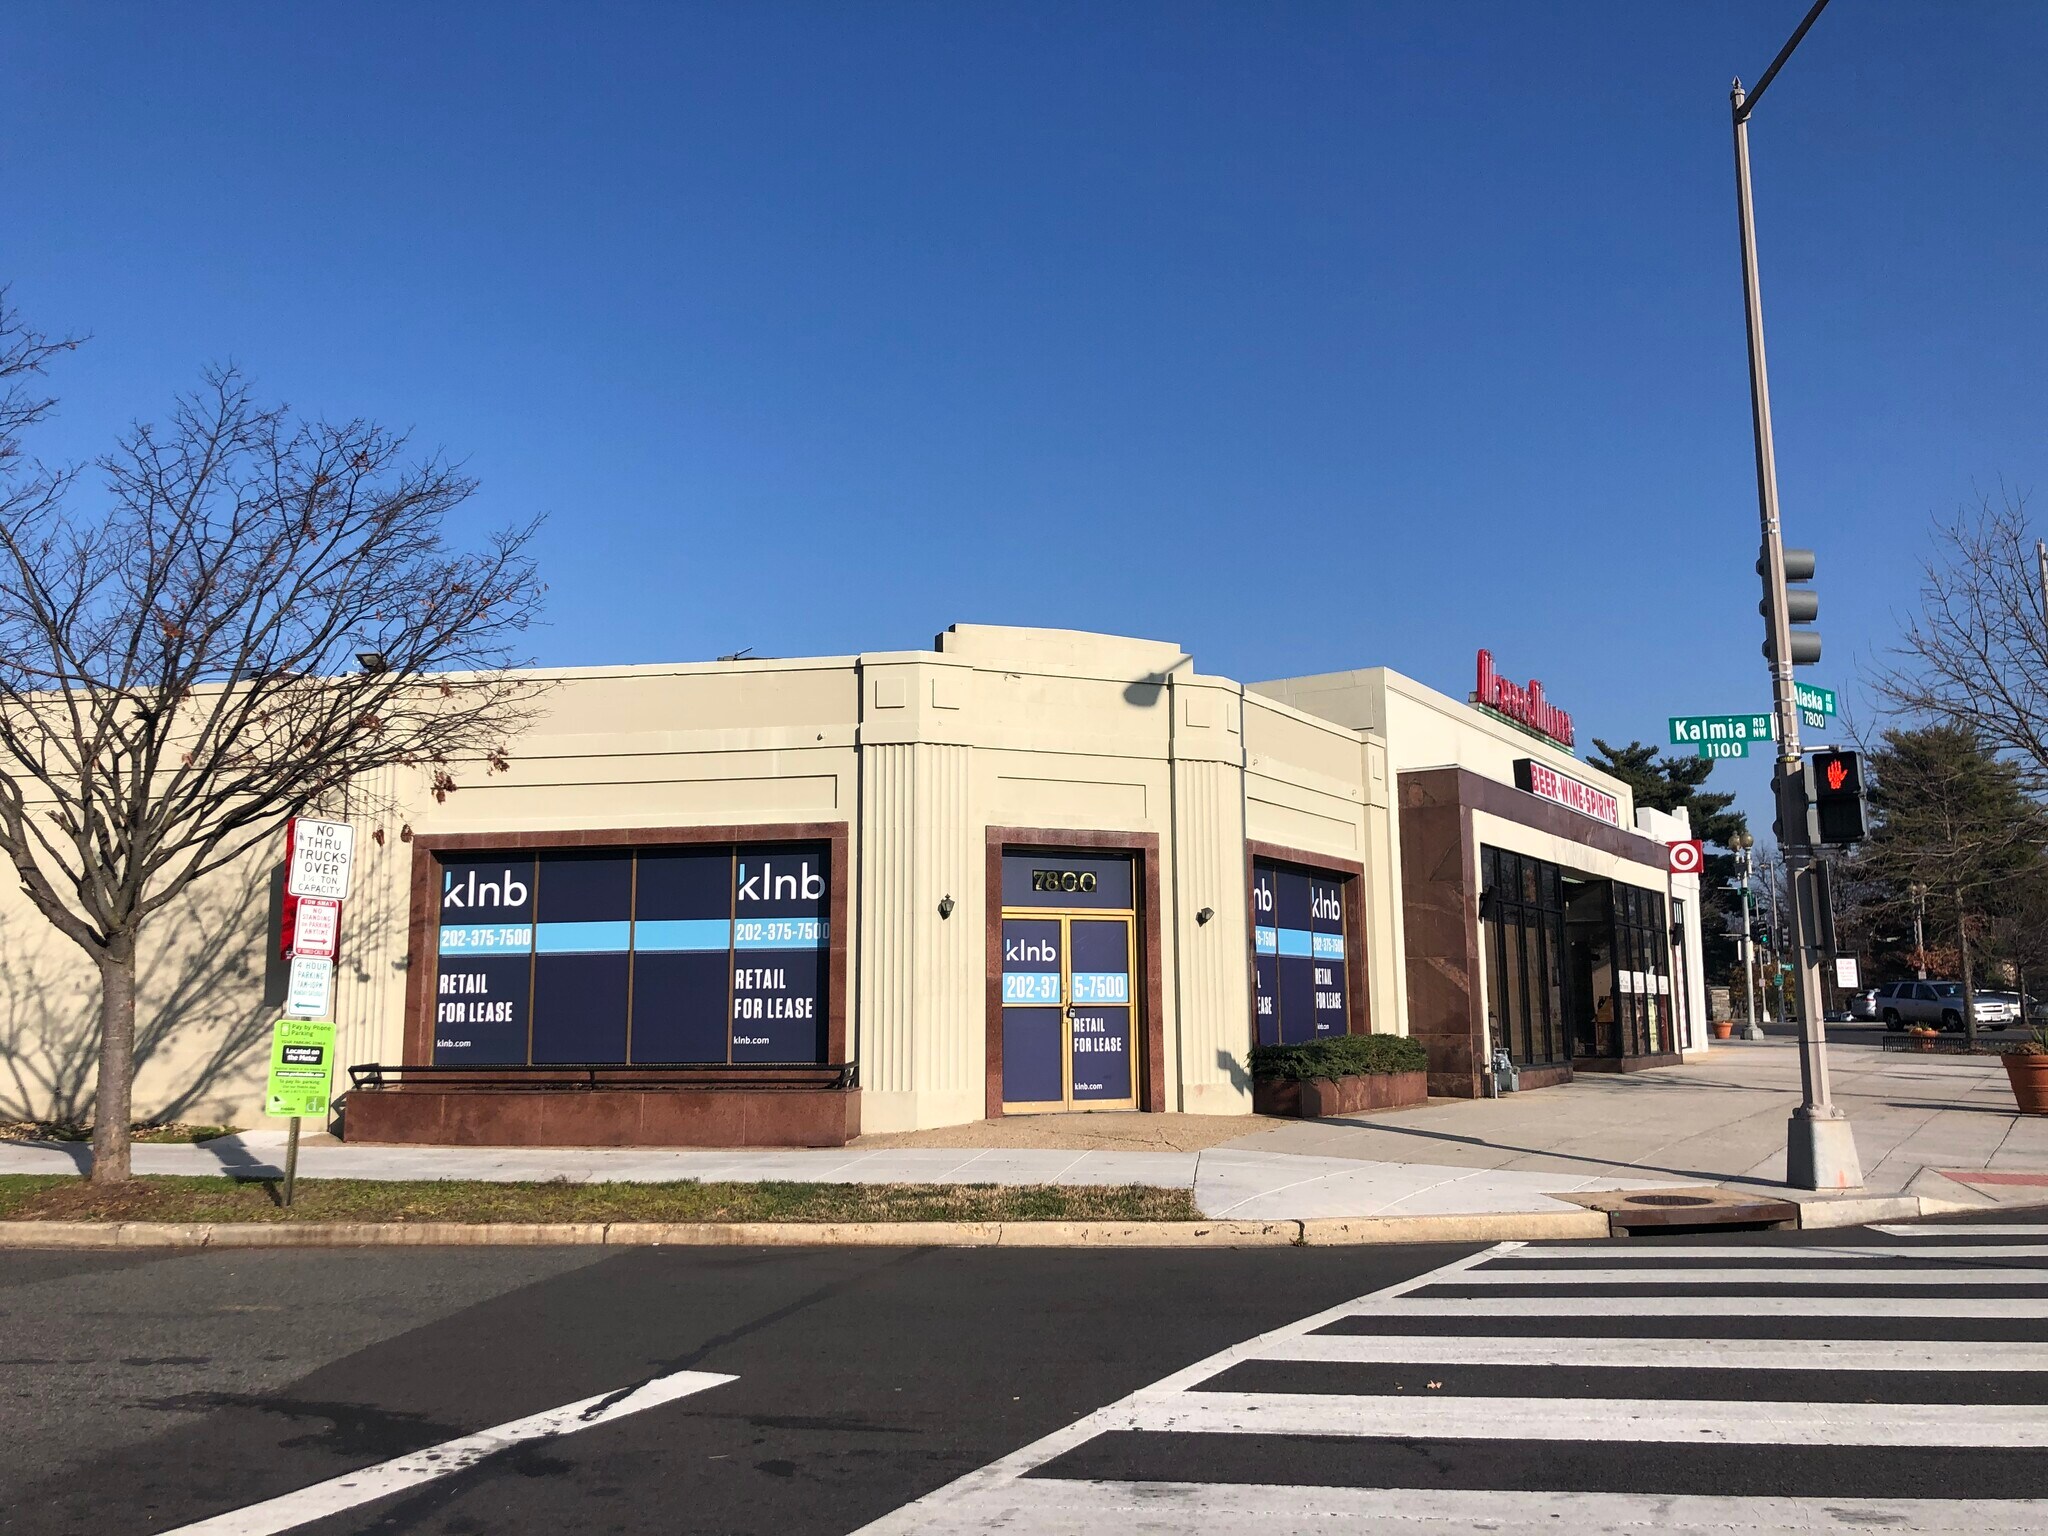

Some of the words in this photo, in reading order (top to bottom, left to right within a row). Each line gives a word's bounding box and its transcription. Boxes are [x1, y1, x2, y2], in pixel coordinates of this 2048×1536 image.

[1794, 685, 1823, 711] Alaska
[1804, 710, 1824, 728] 7800
[1675, 718, 1746, 741] Kalmia
[1752, 717, 1765, 728] RD
[1752, 727, 1767, 738] NW
[1706, 742, 1742, 758] 1100
[316, 825, 334, 838] NO
[307, 836, 342, 851] THRU
[298, 848, 347, 864] TRUCKS
[304, 861, 339, 876] OVER
[320, 875, 338, 885] TON
[443, 868, 529, 908] klnb
[738, 861, 826, 901] klnb
[1033, 870, 1098, 892] 7800
[298, 882, 341, 895] CAPACITY
[1253, 878, 1274, 912] nb
[1311, 886, 1341, 921] klnb
[302, 913, 332, 922] STANDING
[441, 927, 532, 947] 202-375-7500
[736, 922, 831, 942] 202-375-7500
[1005, 938, 1057, 962] klnb
[305, 961, 328, 971] HOUR
[297, 970, 325, 980] PARKING
[734, 967, 787, 990] RETAIL
[1314, 967, 1333, 986] RETAIL
[439, 972, 489, 995] RETAIL
[733, 997, 763, 1020] FOR
[766, 996, 814, 1019] LEASE
[1257, 996, 1273, 1015] EASE
[1315, 991, 1326, 1009] FOR
[1326, 992, 1342, 1009] LEASE
[438, 1001, 466, 1023] FOR
[468, 1000, 513, 1023] LEASE
[291, 1023, 303, 1031] Pay
[312, 1024, 332, 1032] Phone
[1073, 1017, 1106, 1033] RETAIL
[291, 1029, 314, 1038] Parking
[733, 1035, 770, 1046] klnb.com
[285, 1047, 311, 1055] Located
[436, 1038, 472, 1049] klnb.com
[1074, 1037, 1093, 1053] FOR
[1094, 1036, 1122, 1052] LEASE
[286, 1053, 299, 1061] the
[1074, 1082, 1103, 1091] klnb.com
